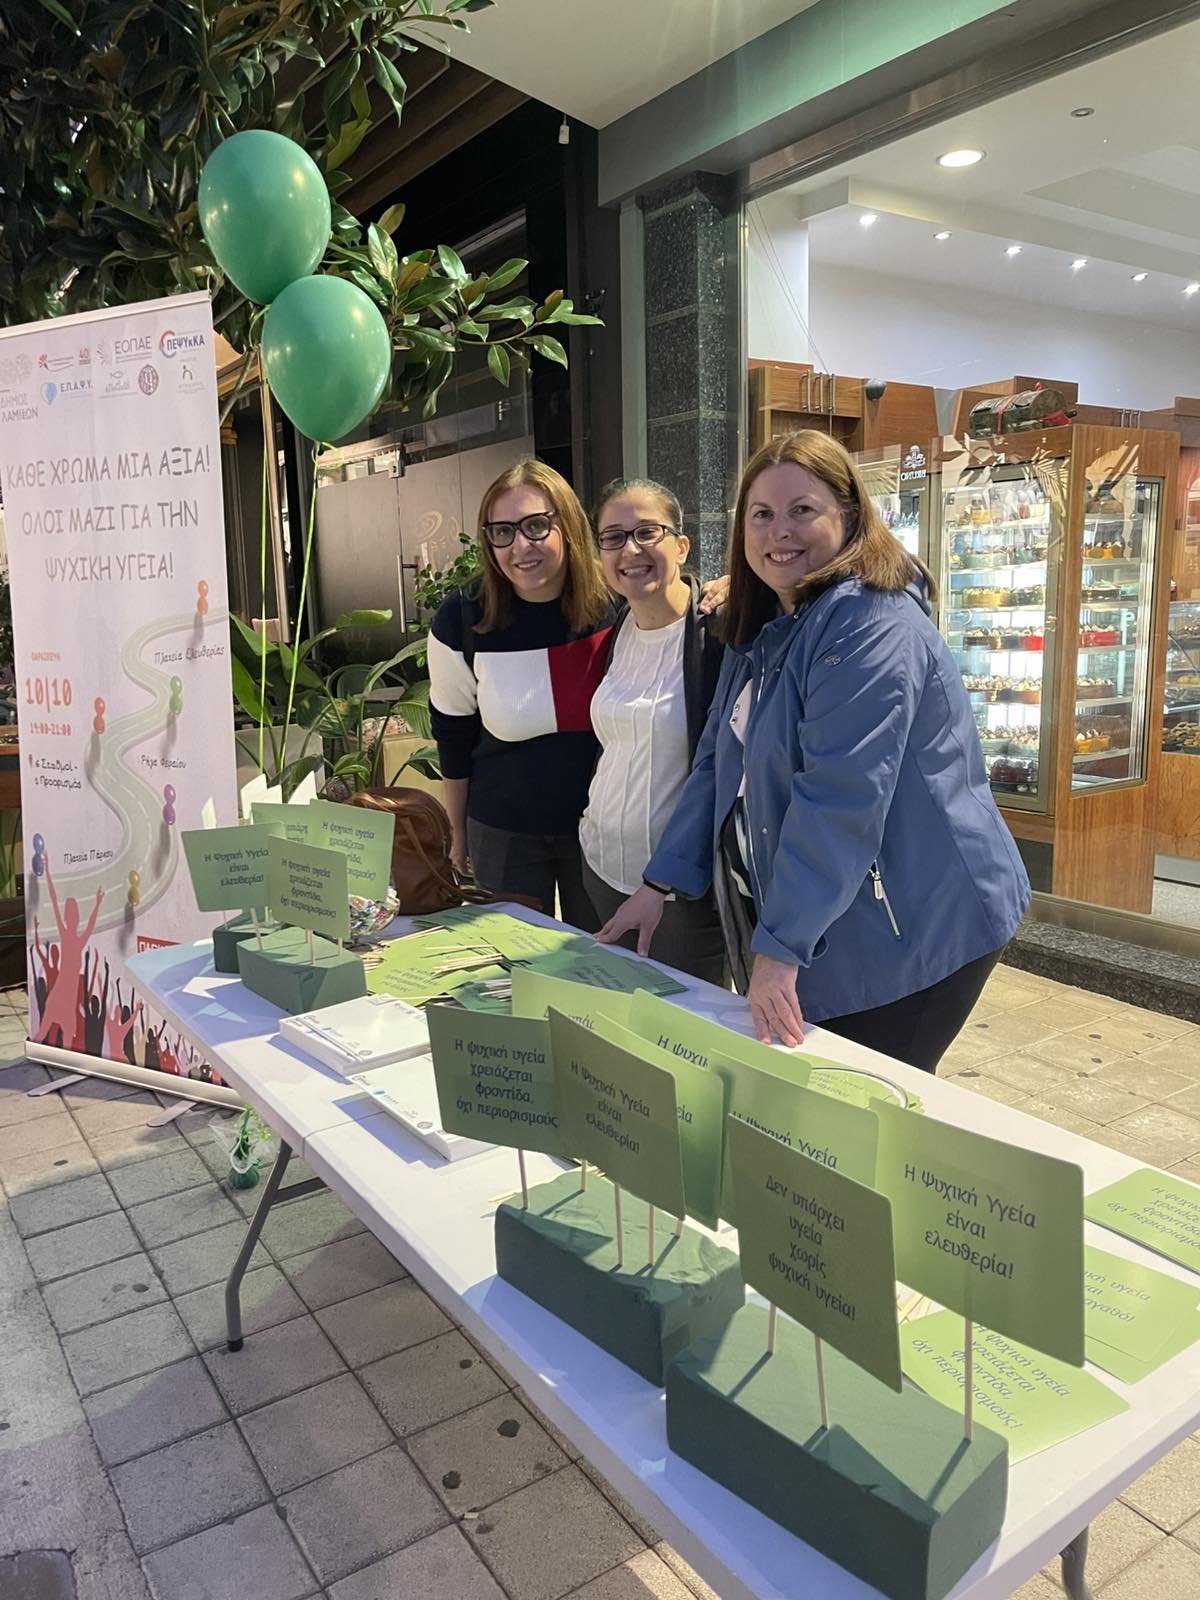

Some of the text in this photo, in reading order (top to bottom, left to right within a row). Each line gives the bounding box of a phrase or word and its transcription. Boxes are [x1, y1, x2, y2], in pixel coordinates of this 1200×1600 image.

[114, 336, 152, 354] ΕΟΠΑΕ
[6, 444, 210, 488] ΚΑΘΕ ΧΡΩΜΑ ΜΙΑ ΑΞΙΑ!
[22, 500, 199, 535] ΟΛΟΙ ΜΑΖΙ ΓΙΑ ΤΗΝ
[45, 551, 174, 582] ΨΥΧΙΚΗ ΥΓΕΙΑ!
[455, 1040, 545, 1064] Η ψυχική υγεία
[657, 1035, 670, 1049] Η
[470, 1063, 533, 1083] χρειάζεται
[571, 1060, 578, 1075] Η
[619, 1088, 650, 1118] Υγεία
[456, 1096, 472, 1113] όχι
[598, 1100, 622, 1122] είναι
[766, 1175, 844, 1232] Δεν υπάρχει
[904, 1164, 1036, 1228] Η Ψυχική Υγεία
[790, 1216, 822, 1246] υγεία
[946, 1210, 985, 1239] είναι
[790, 1242, 826, 1278] χωρίς
[924, 1230, 1013, 1279] ελευθερία!
[768, 1252, 856, 1320] ψυχική υγεία!
[1111, 1282, 1151, 1301] υγεία
[912, 1339, 933, 1354] όχι
[986, 1333, 1032, 1368] ψυχική
[1031, 1368, 1071, 1398] υγεία
